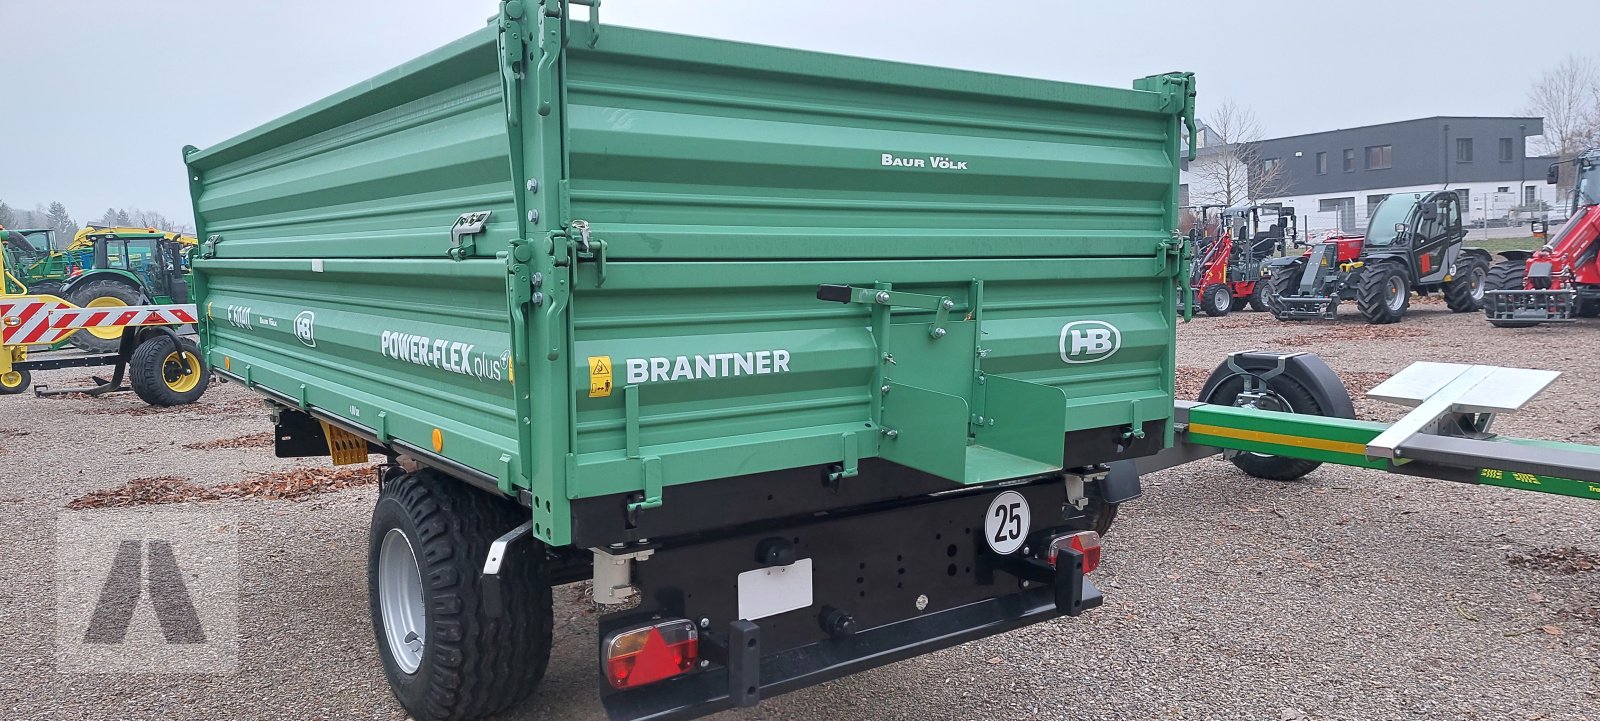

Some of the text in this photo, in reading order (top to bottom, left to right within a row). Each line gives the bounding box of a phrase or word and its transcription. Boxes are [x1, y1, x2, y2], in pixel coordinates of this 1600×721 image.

[381, 330, 501, 383] POWER-FLEX plus
[1070, 328, 1112, 356] HB
[626, 349, 790, 384] BRANTNER
[994, 502, 1022, 543] 25
